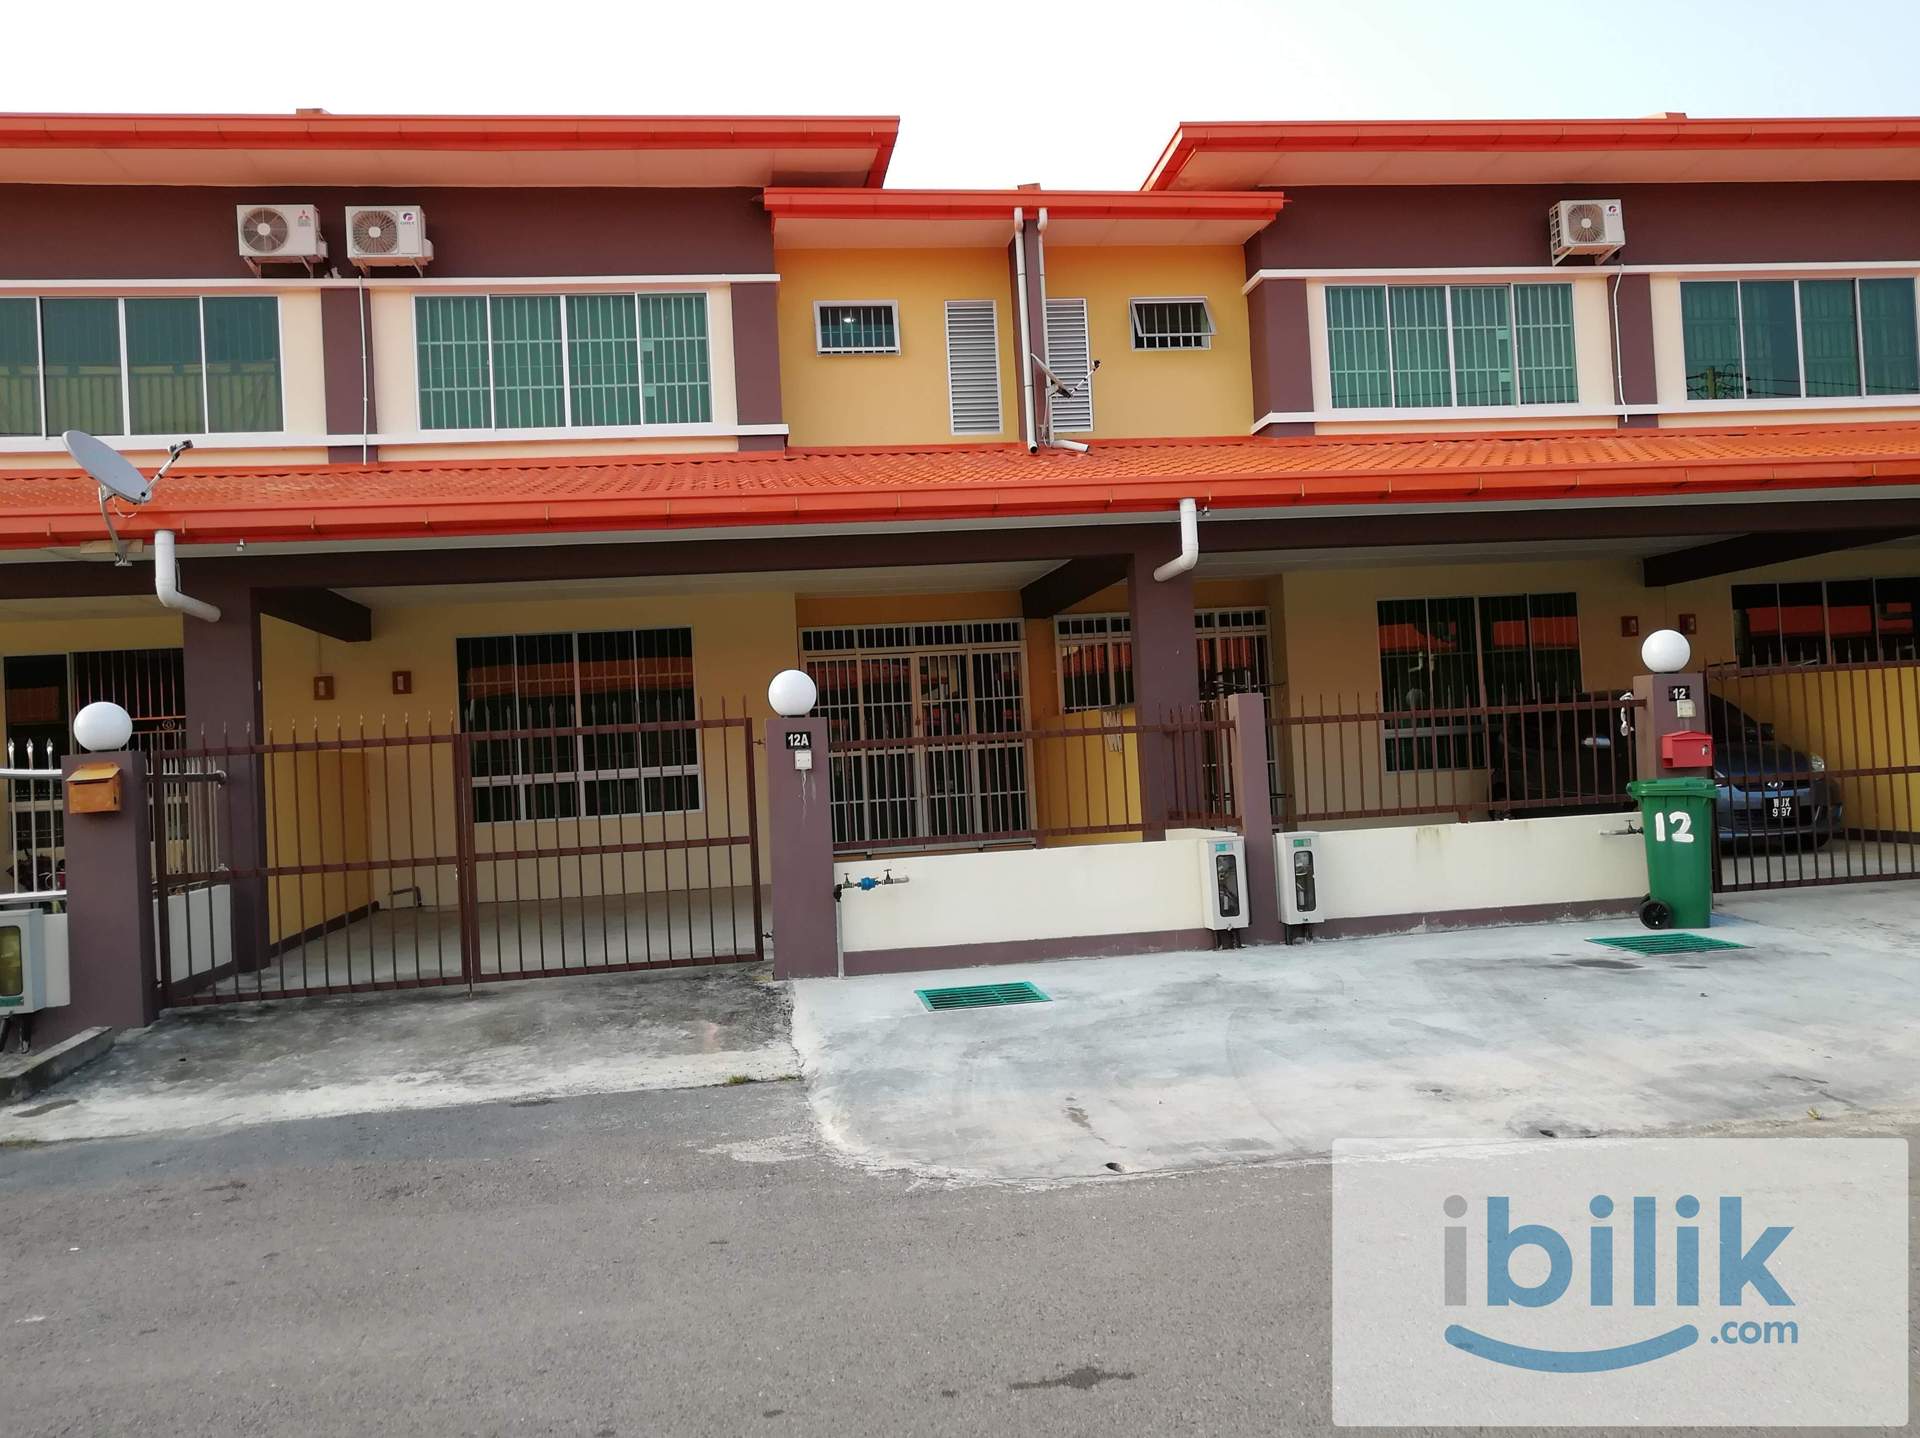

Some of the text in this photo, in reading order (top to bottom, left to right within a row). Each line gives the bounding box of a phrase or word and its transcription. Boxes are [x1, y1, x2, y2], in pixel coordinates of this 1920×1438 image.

[1673, 687, 1686, 700] 12
[788, 733, 809, 747] 12A
[1655, 811, 1694, 843] 12
